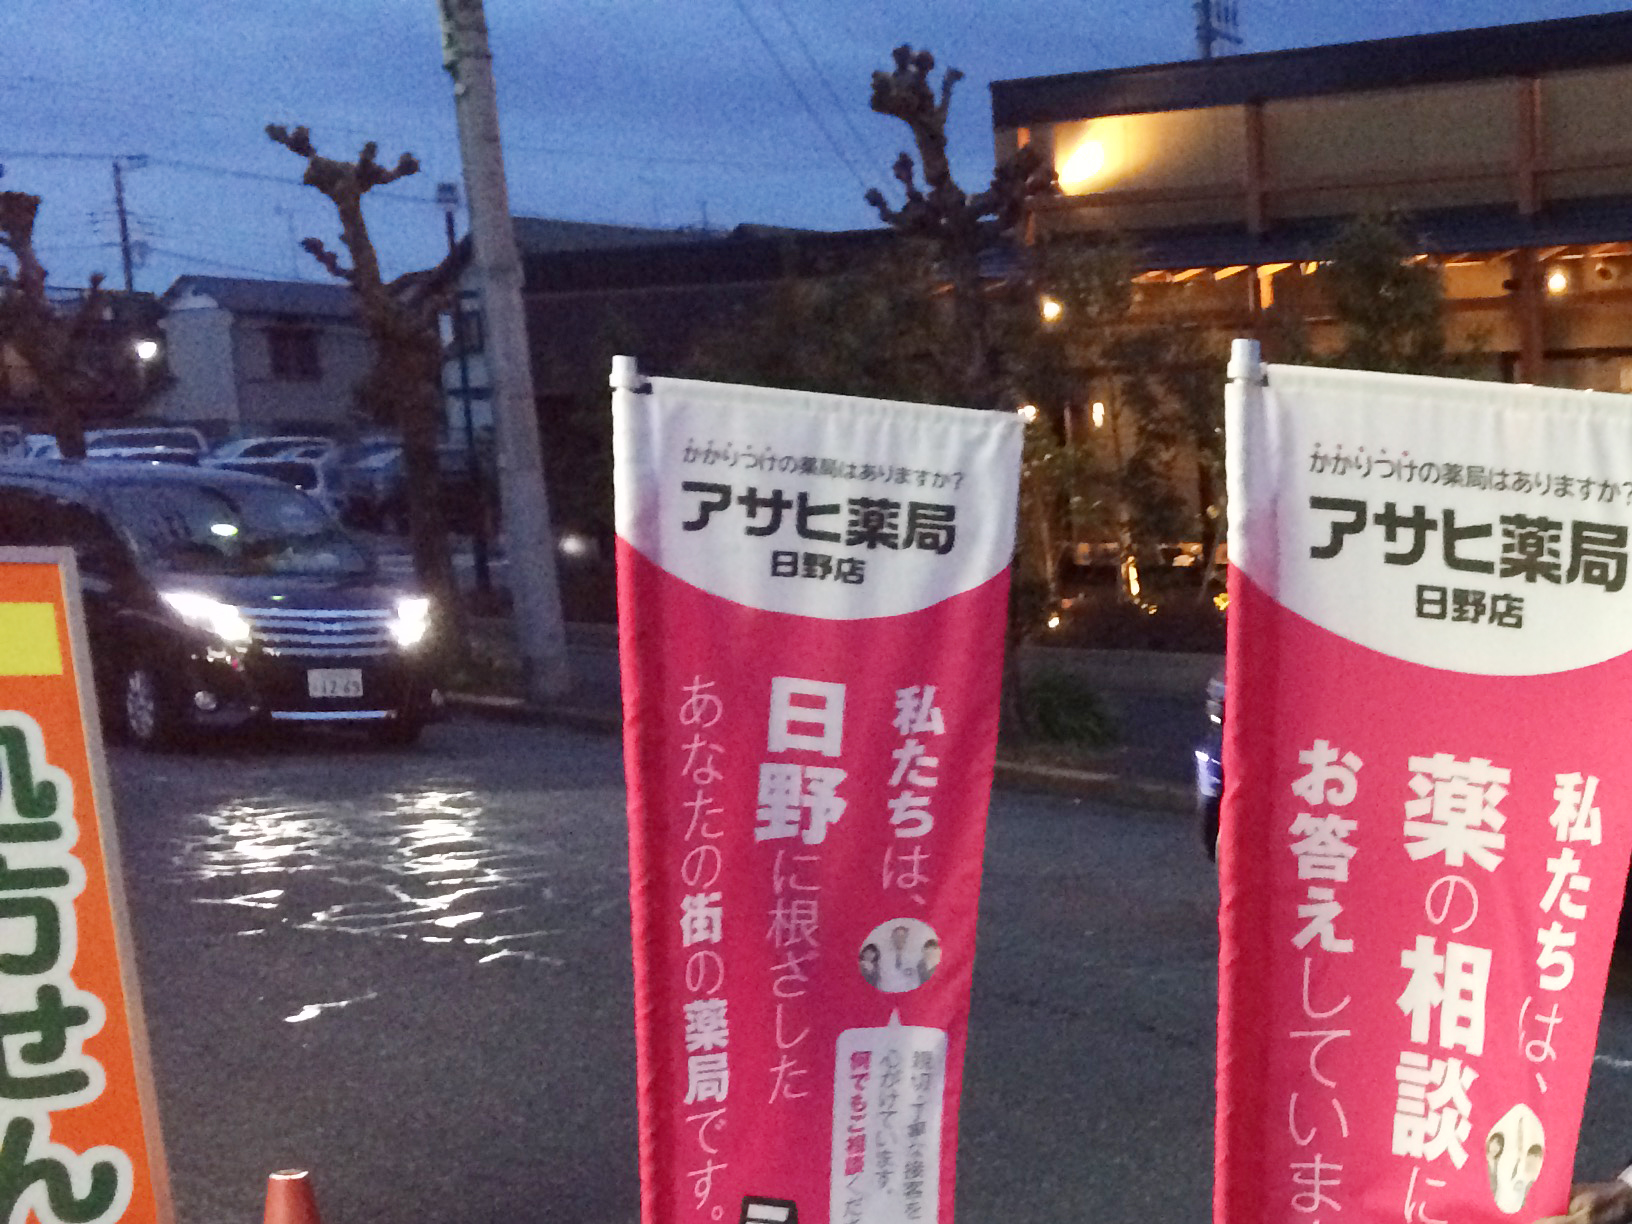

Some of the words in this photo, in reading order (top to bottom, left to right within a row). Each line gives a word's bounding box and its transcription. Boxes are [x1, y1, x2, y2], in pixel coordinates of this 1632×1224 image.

[681, 481, 957, 555] アサヒ薬局
[770, 550, 866, 585] 日野店
[1308, 495, 1630, 593] アサヒ薬局
[1415, 584, 1525, 629] 日野店
[882, 684, 946, 905] 私たちは、
[678, 674, 730, 1221] あなたの街の薬局です。
[754, 676, 848, 1104] 日野に根ざした
[1518, 771, 1602, 1093] 私たちは、
